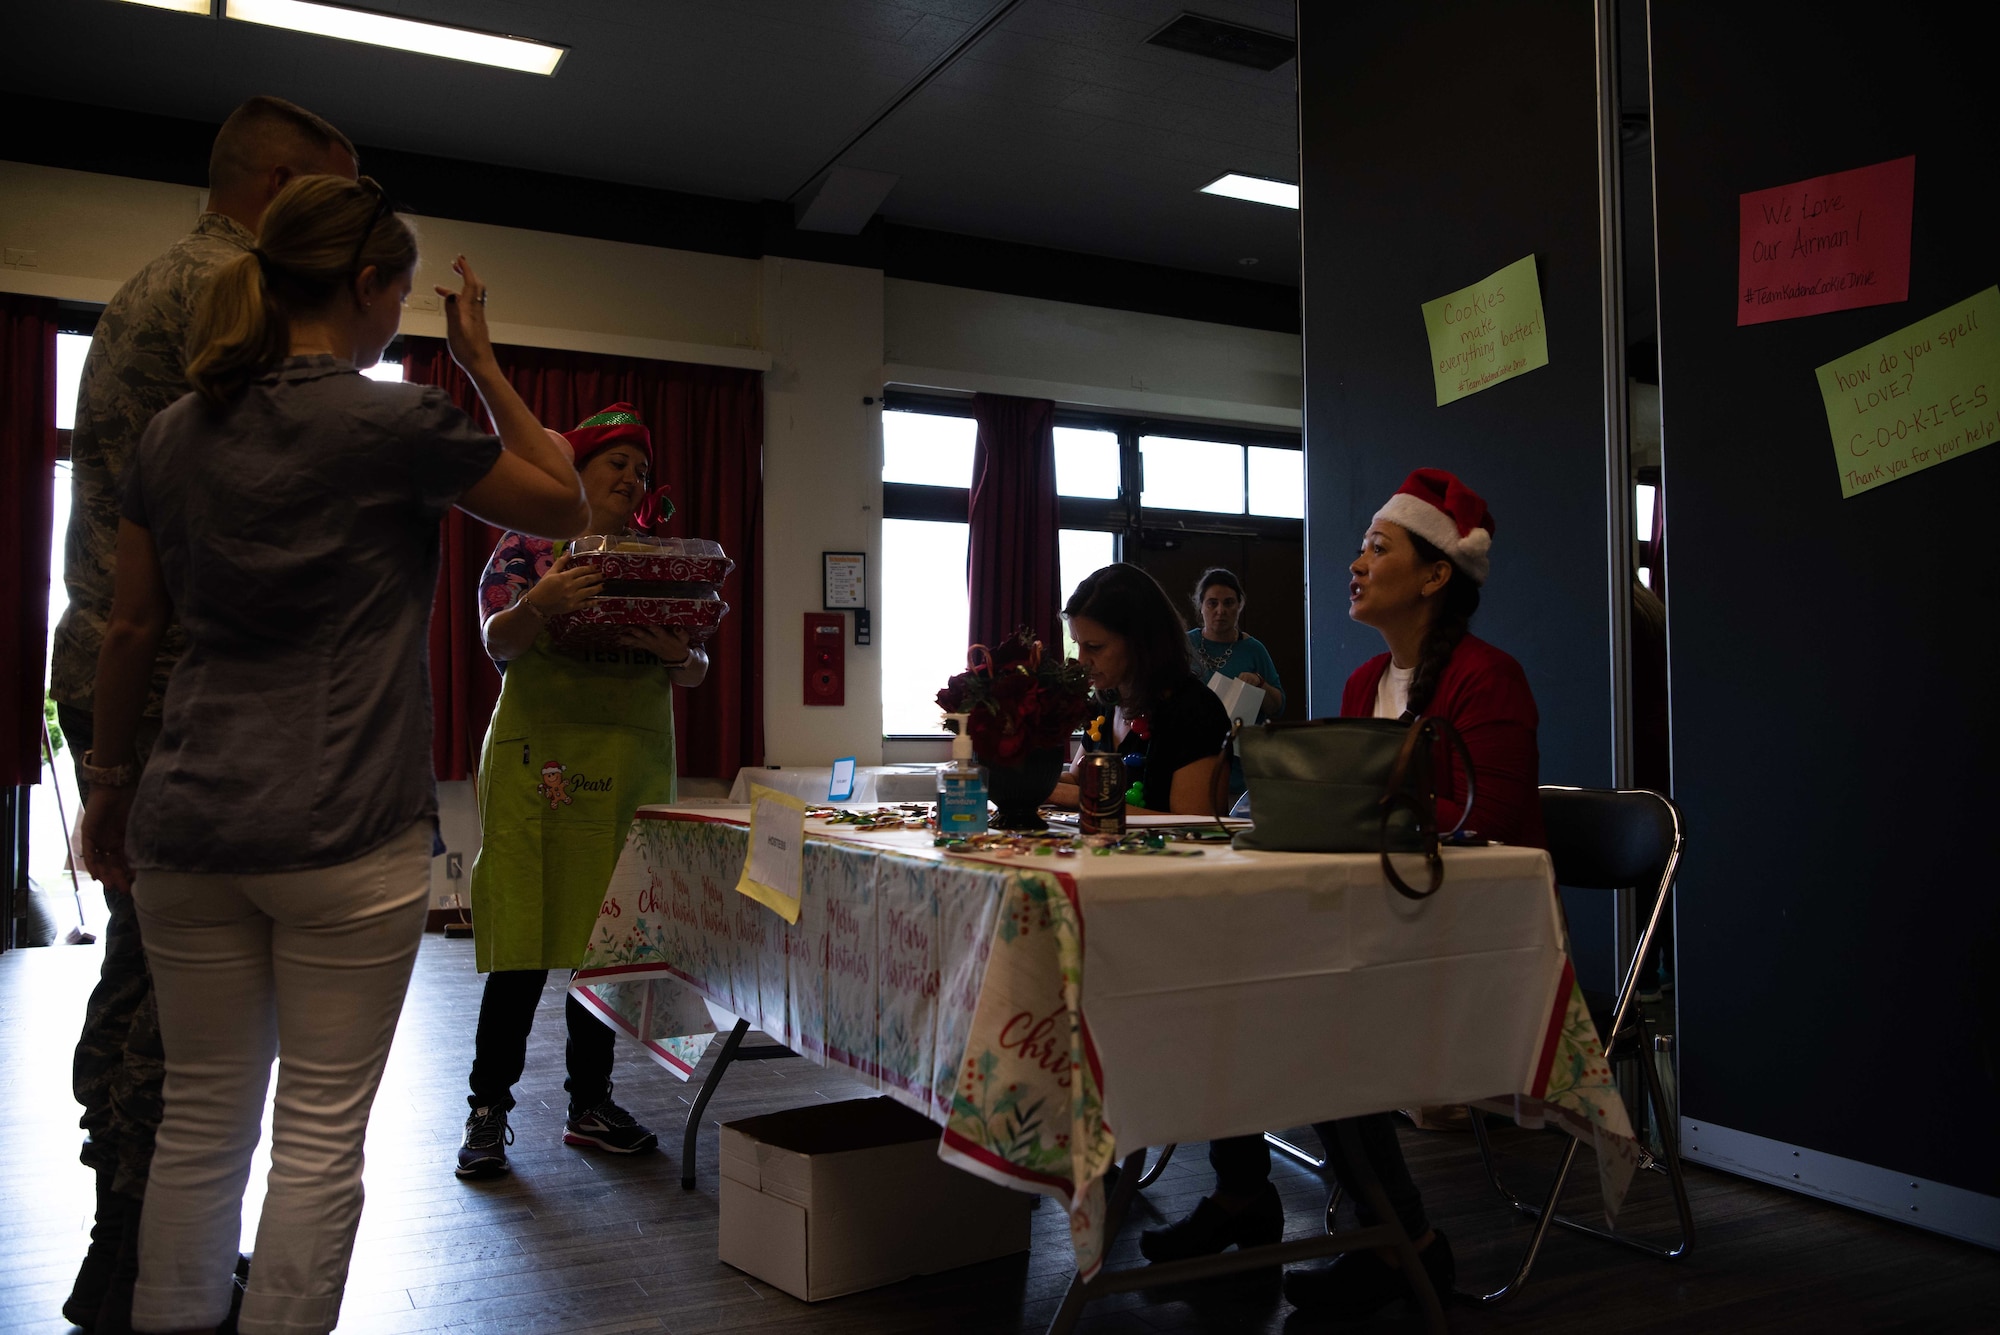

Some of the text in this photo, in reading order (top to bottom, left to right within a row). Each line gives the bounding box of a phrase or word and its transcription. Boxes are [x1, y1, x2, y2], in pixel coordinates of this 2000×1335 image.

[1762, 193, 1845, 225] We Love
[1443, 287, 1506, 325] Cookies
[1439, 309, 1542, 376] everything better!
[1460, 317, 1497, 344] make
[1834, 309, 1978, 392] how do you spell
[1854, 373, 1913, 415] LOVE?
[1850, 384, 1989, 457] C-O-O-K-I-E-S
[1845, 464, 1885, 490] Thank
[1886, 459, 1908, 479] you
[1911, 446, 1931, 464] for
[1933, 435, 1961, 460] your
[570, 773, 613, 792] Pearl
